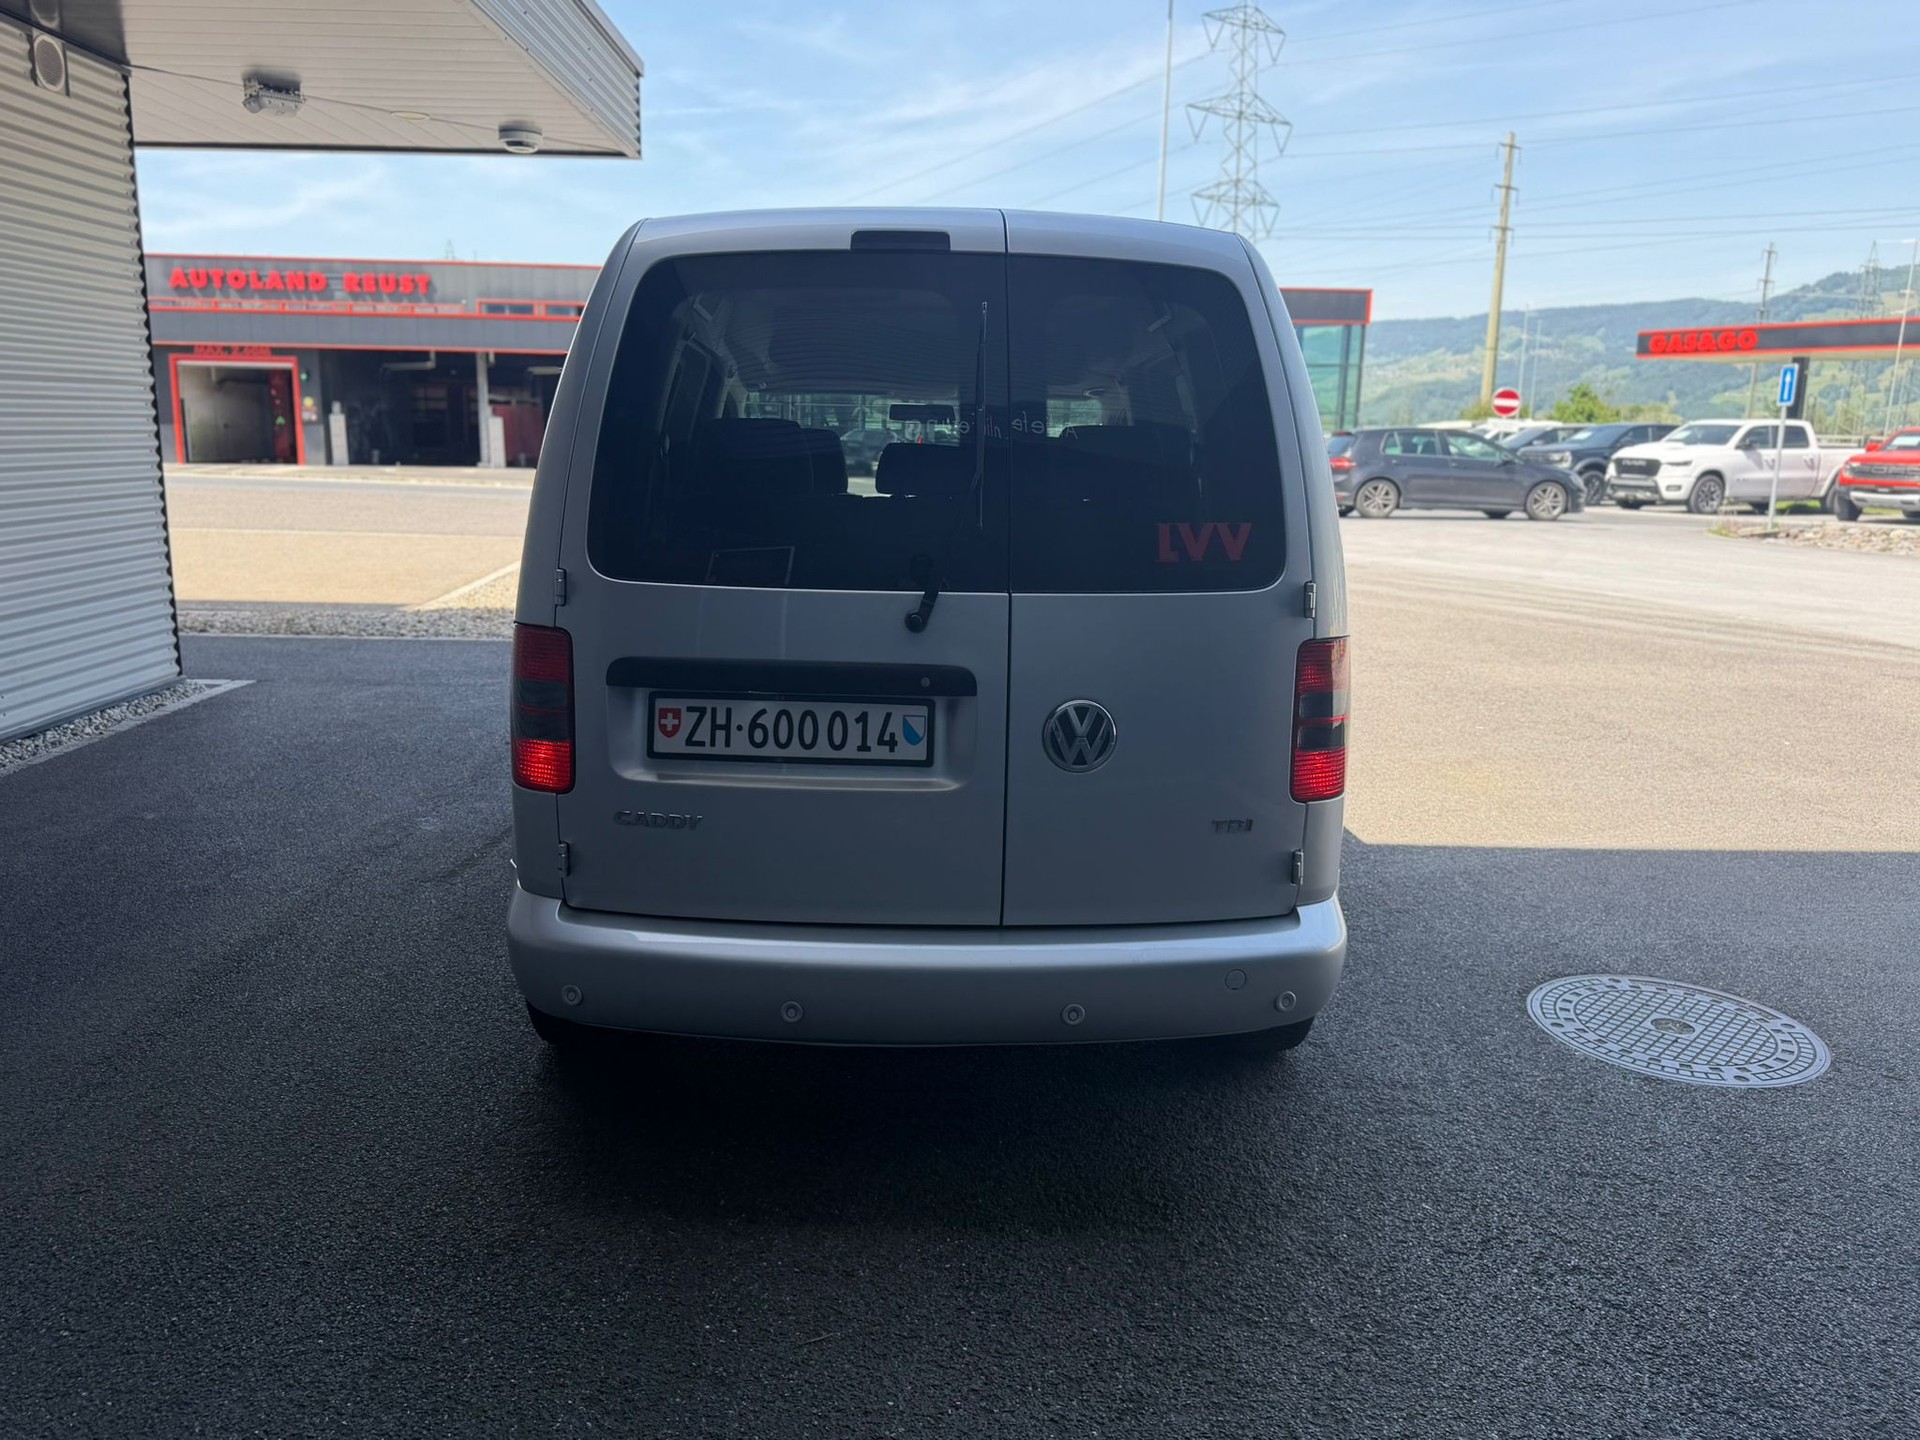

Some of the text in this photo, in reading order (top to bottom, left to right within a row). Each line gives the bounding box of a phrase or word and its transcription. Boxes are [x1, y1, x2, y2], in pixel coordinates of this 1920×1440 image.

[169, 267, 432, 295] AUTOLAND REUST
[1649, 329, 1758, 353] GASAGO
[614, 810, 704, 831] CADDY
[1211, 818, 1253, 834] TDI
